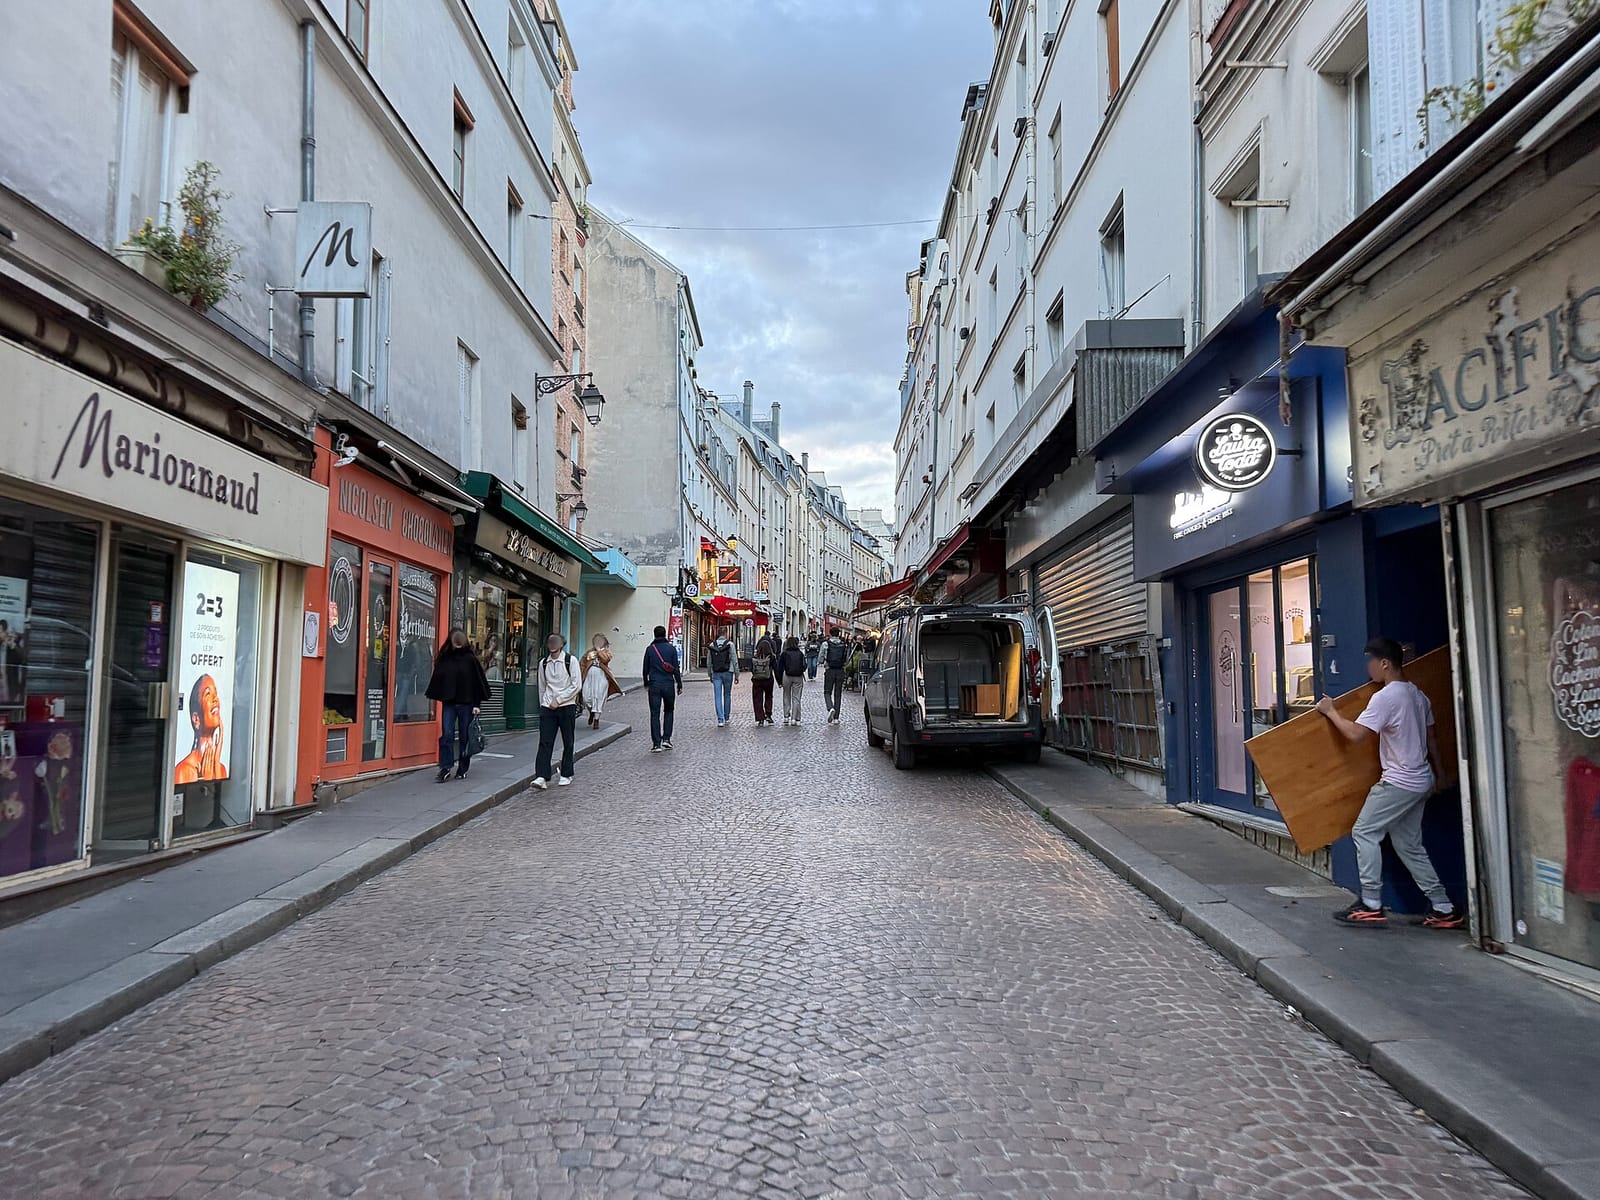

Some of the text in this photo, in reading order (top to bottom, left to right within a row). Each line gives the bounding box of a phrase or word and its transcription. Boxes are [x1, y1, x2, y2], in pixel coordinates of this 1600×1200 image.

[52, 392, 259, 515] Marionnaud
[1209, 434, 1267, 459] Laura
[1211, 451, 1262, 472] Todd
[339, 479, 454, 556] NICOLSEN CHOCOLATIER
[506, 528, 520, 552] Le
[196, 593, 223, 618] 2=3
[1286, 608, 1304, 620] COFFEE
[191, 653, 224, 667] OFFERT
[1572, 642, 1599, 665] Lin
[1577, 703, 1600, 725] Soi
